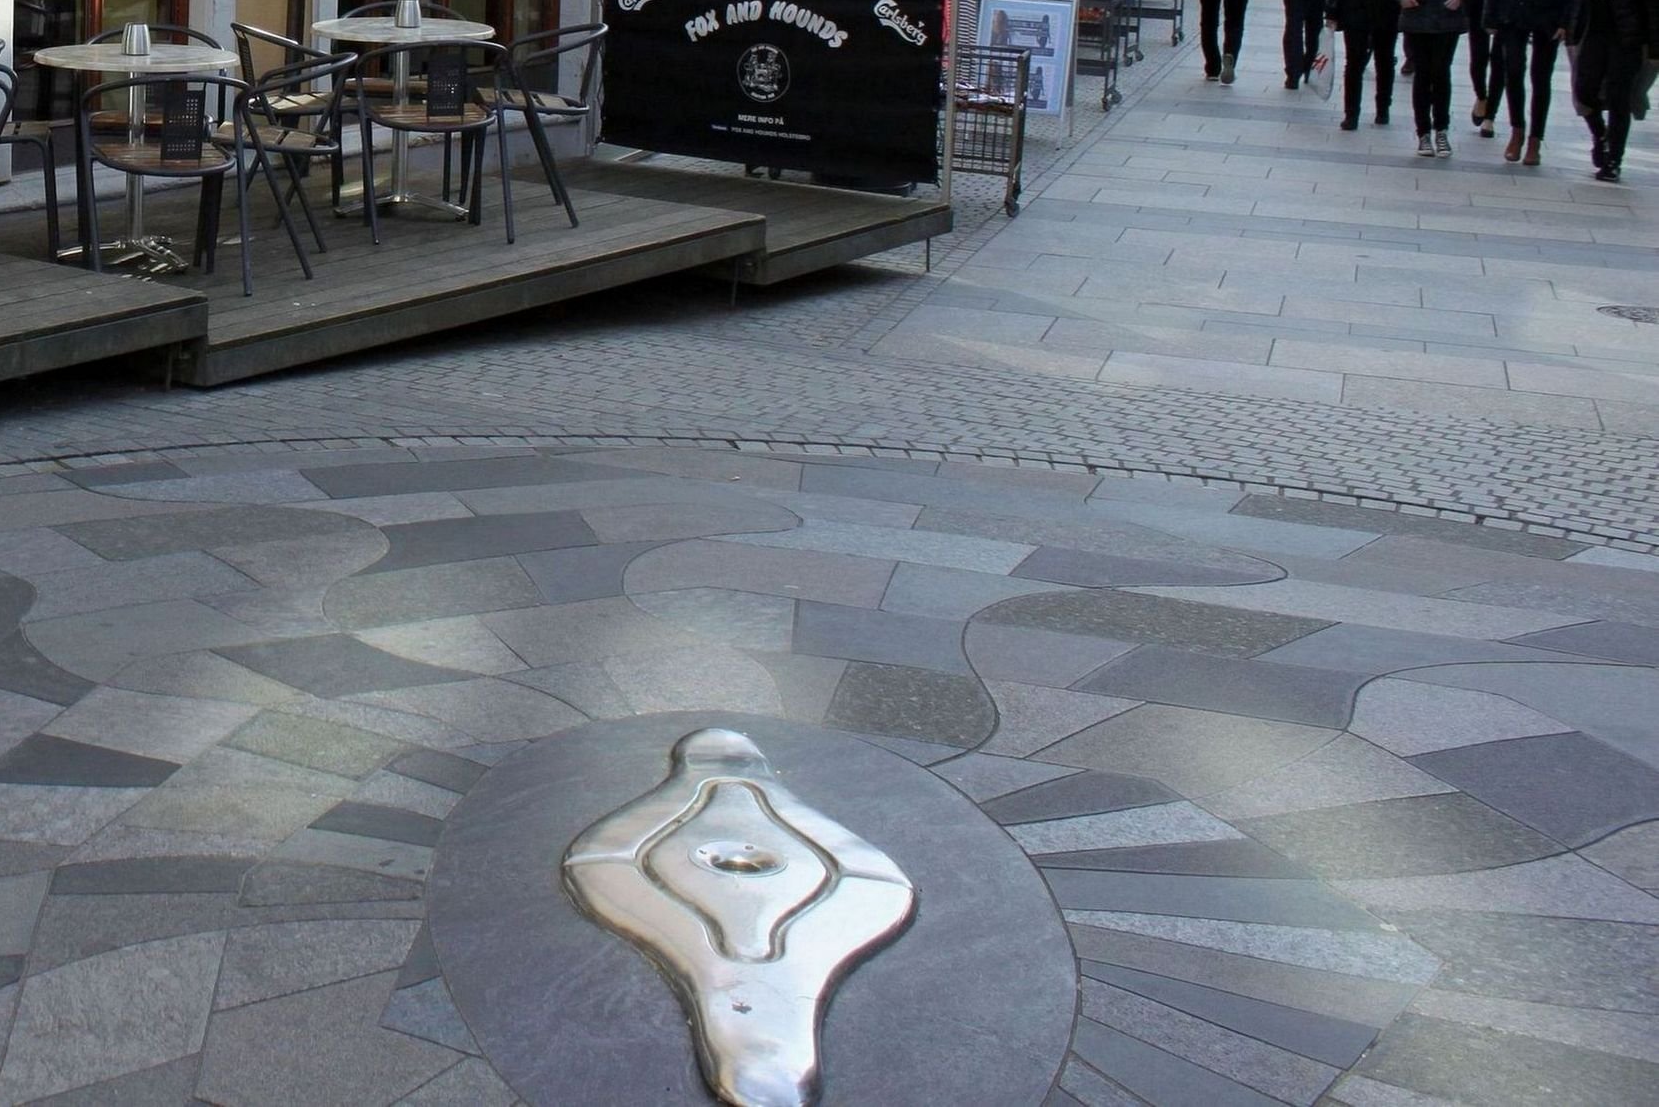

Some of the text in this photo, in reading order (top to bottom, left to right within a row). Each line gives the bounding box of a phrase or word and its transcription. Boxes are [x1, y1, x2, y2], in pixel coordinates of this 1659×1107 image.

[684, 0, 849, 48] FOX AND HOUNDS
